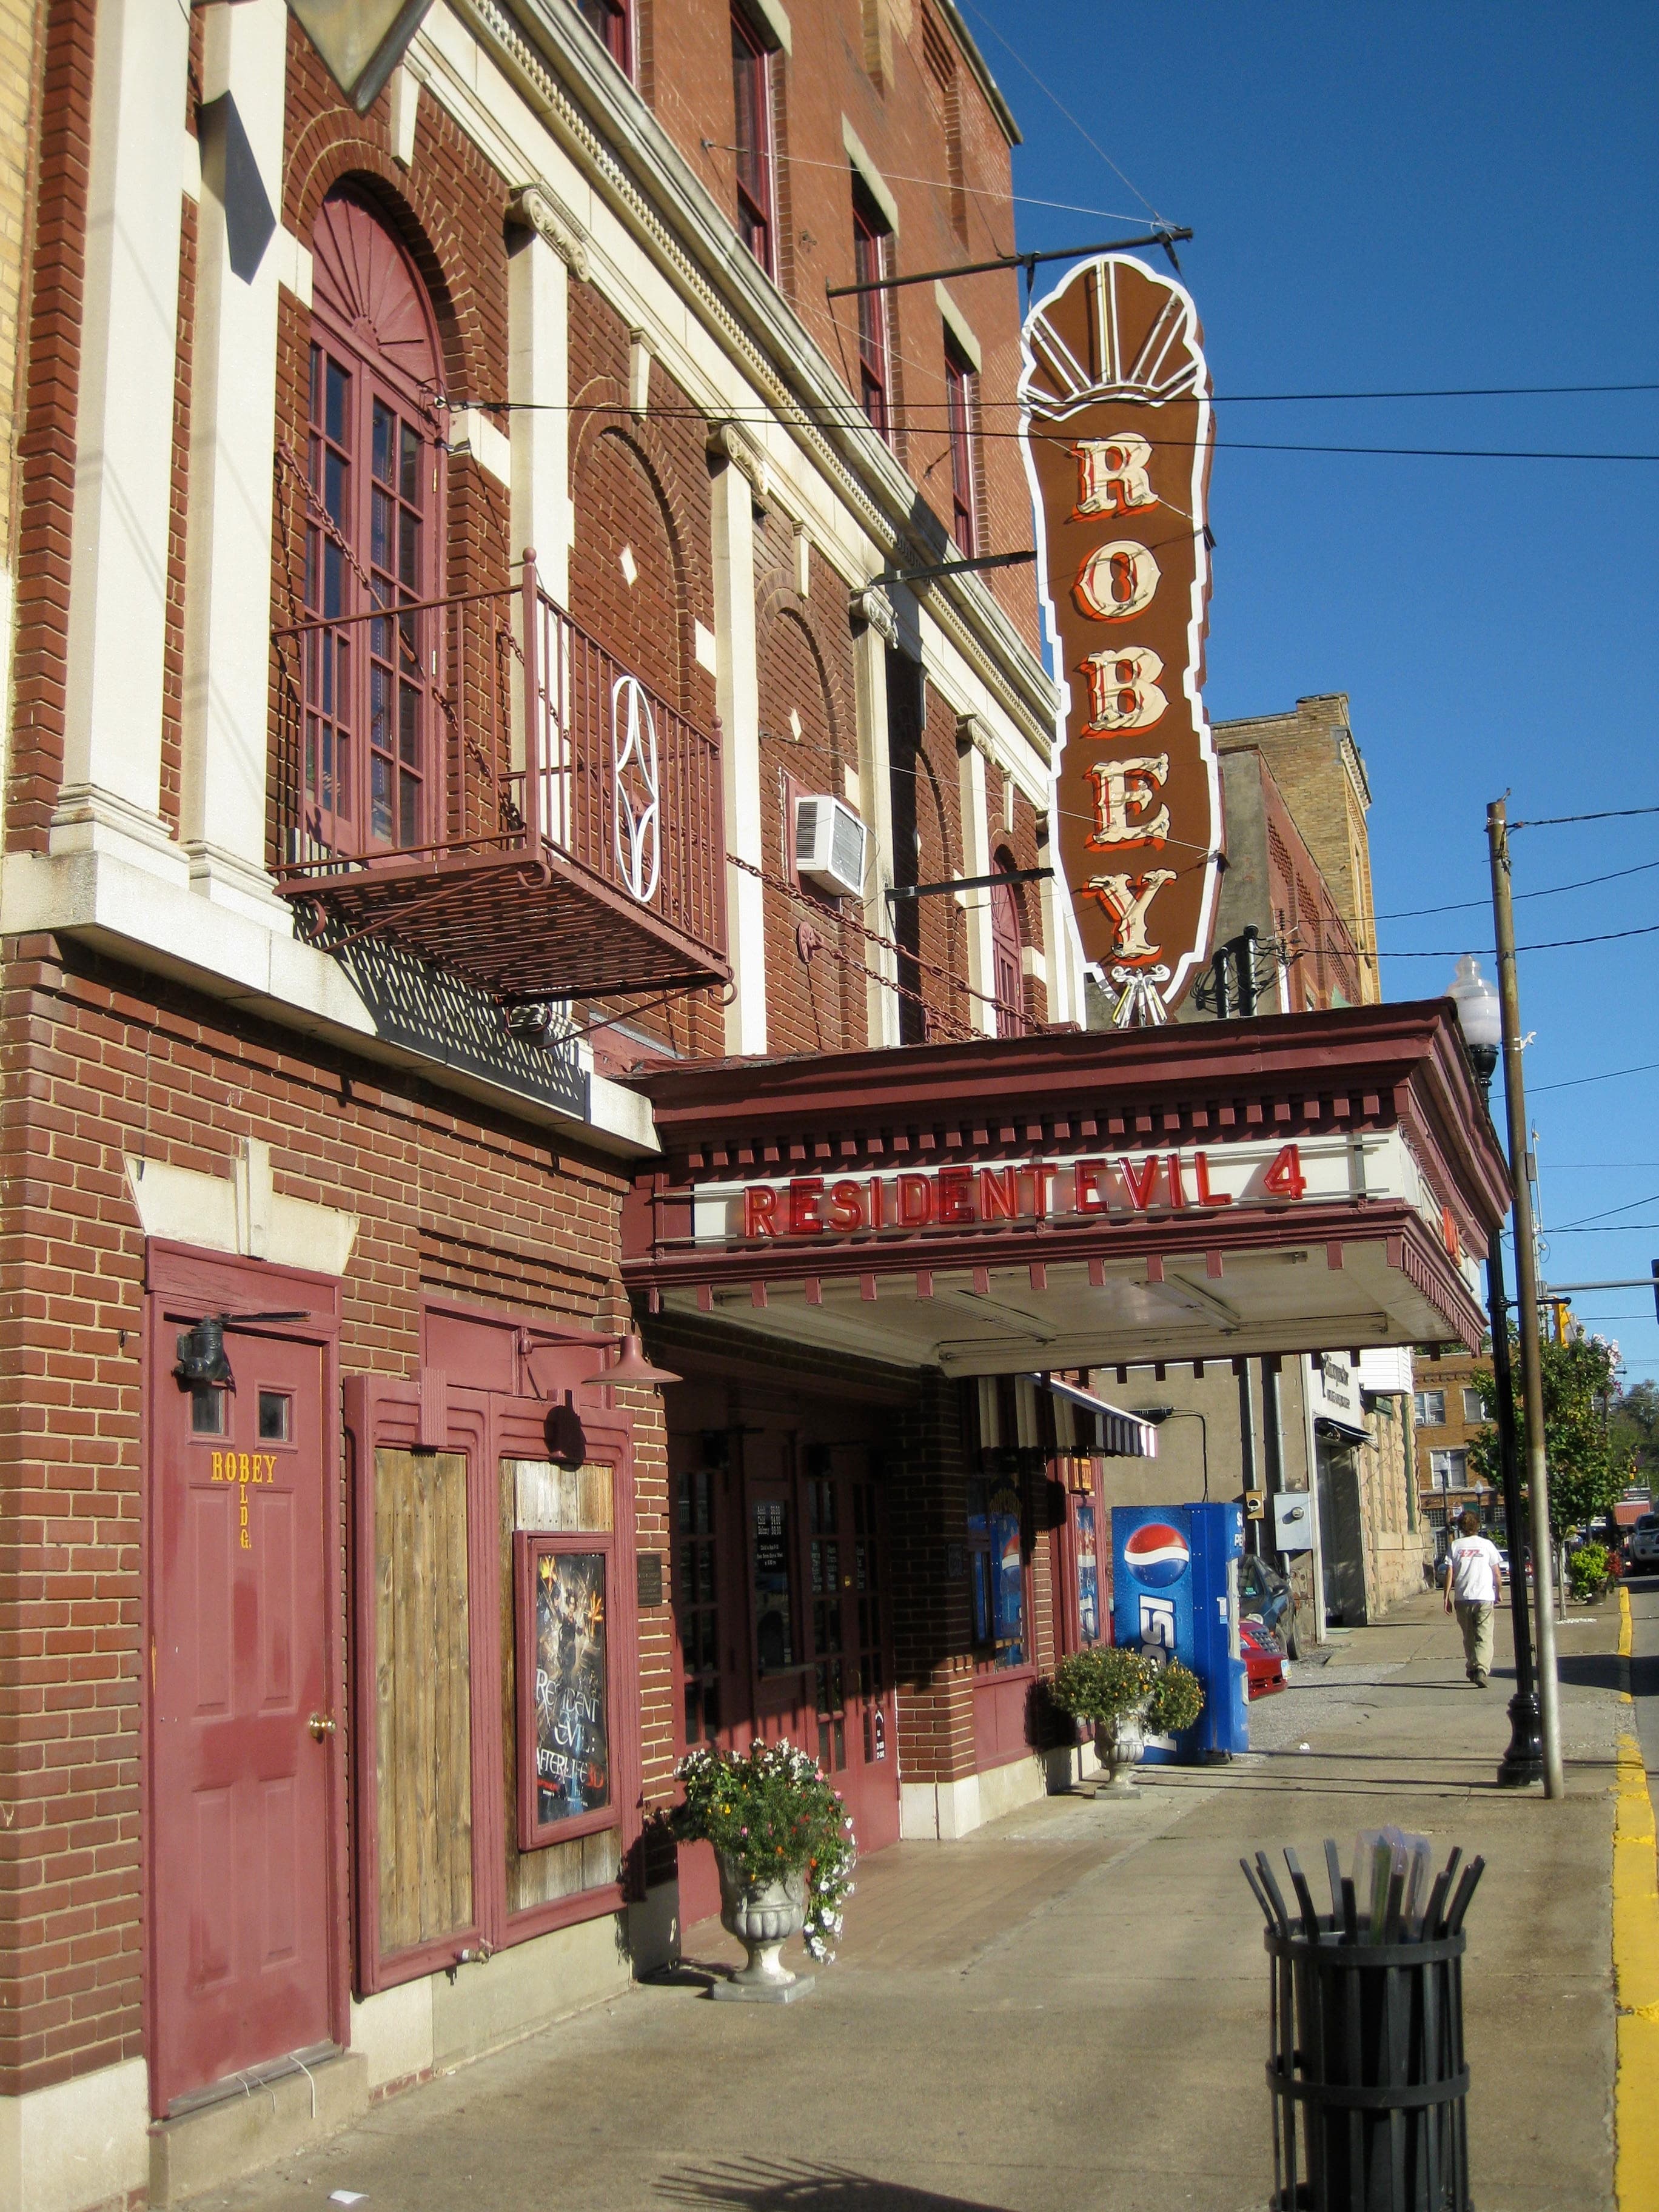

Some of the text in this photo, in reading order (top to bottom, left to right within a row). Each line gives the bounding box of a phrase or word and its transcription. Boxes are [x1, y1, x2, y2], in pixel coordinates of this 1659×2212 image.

[1072, 431, 1176, 963] ROBEY
[743, 1144, 1307, 1238] RESIDENT EVIL 4
[211, 1452, 277, 1483] ROBEY
[536, 1668, 600, 1728] REIDENT
[537, 1746, 588, 1785] AFTERLIFE
